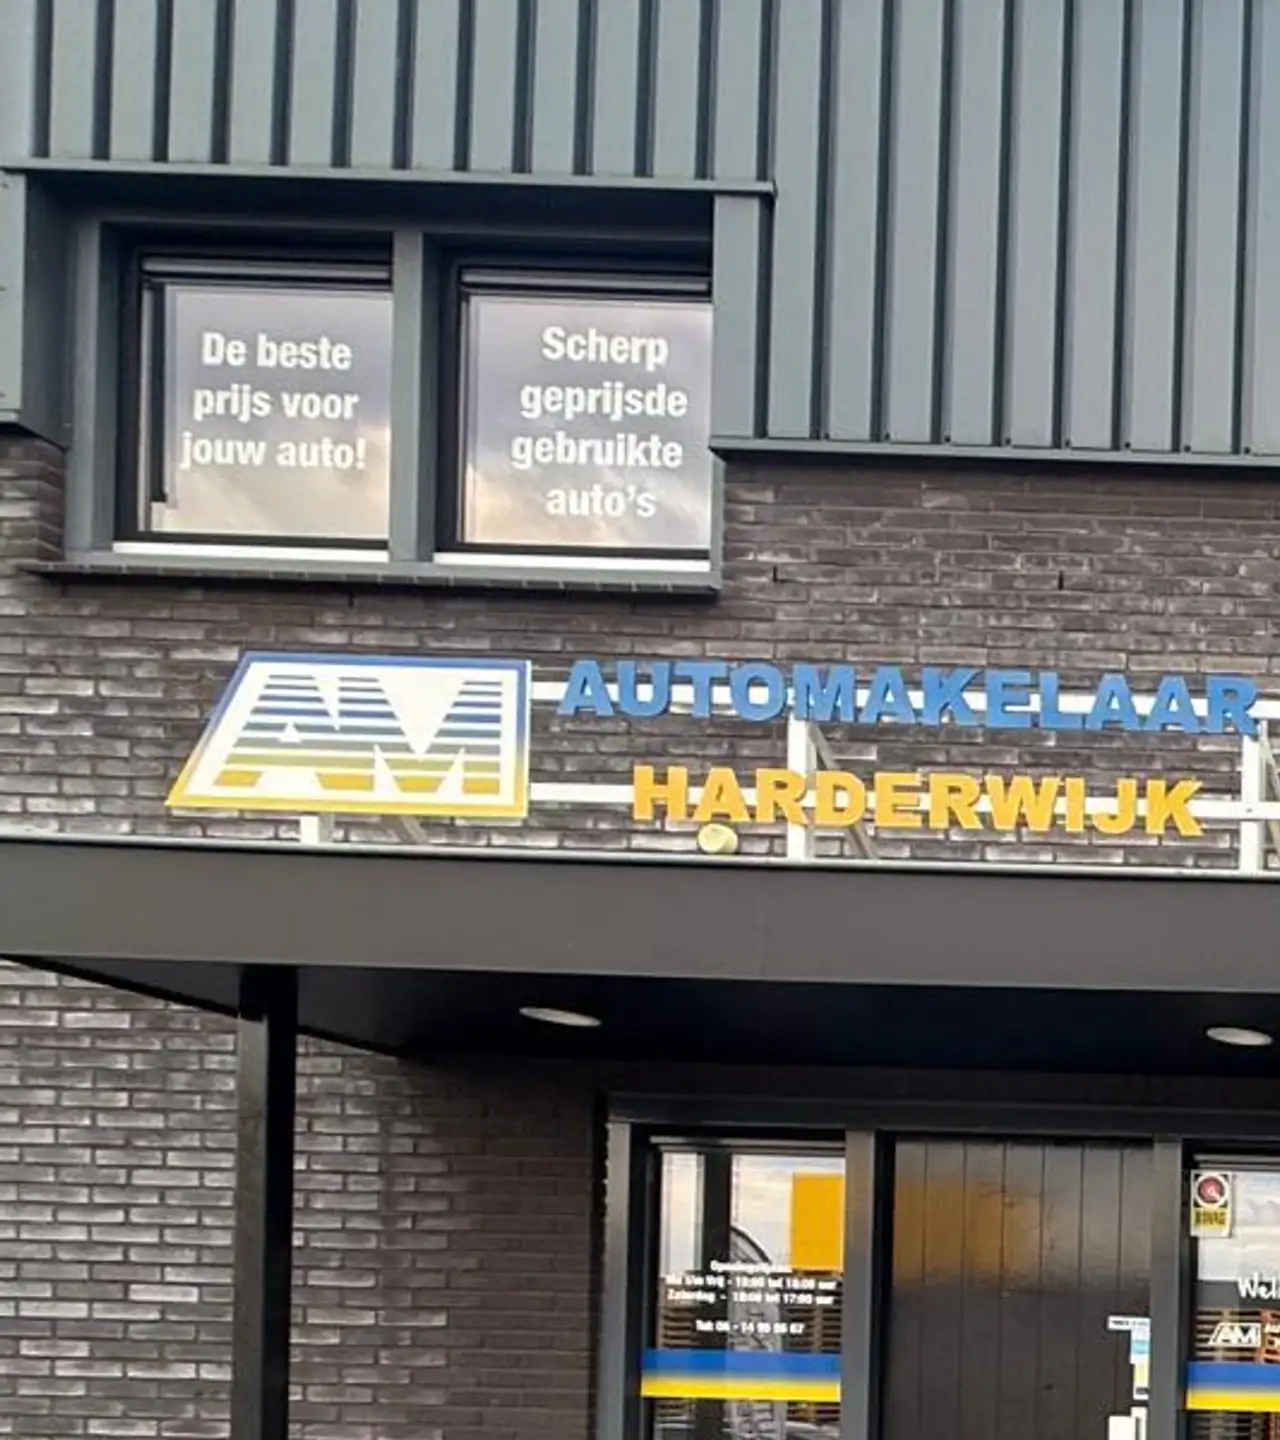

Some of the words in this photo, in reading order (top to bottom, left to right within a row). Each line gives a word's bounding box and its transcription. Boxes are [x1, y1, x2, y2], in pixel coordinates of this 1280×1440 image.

[202, 331, 246, 367] De
[256, 335, 353, 371] beste
[541, 326, 669, 367] Scherp
[193, 385, 272, 422] prijs
[280, 392, 360, 420] voor
[520, 379, 688, 424] geprijsde
[179, 430, 266, 469] jouw
[277, 436, 366, 470] auto!
[511, 430, 683, 471] gebruikte
[545, 485, 657, 518] auto's
[558, 657, 1261, 736] AUTOMAKELAAR
[212, 672, 504, 793] AM
[632, 765, 1203, 836] HARDERWIJK
